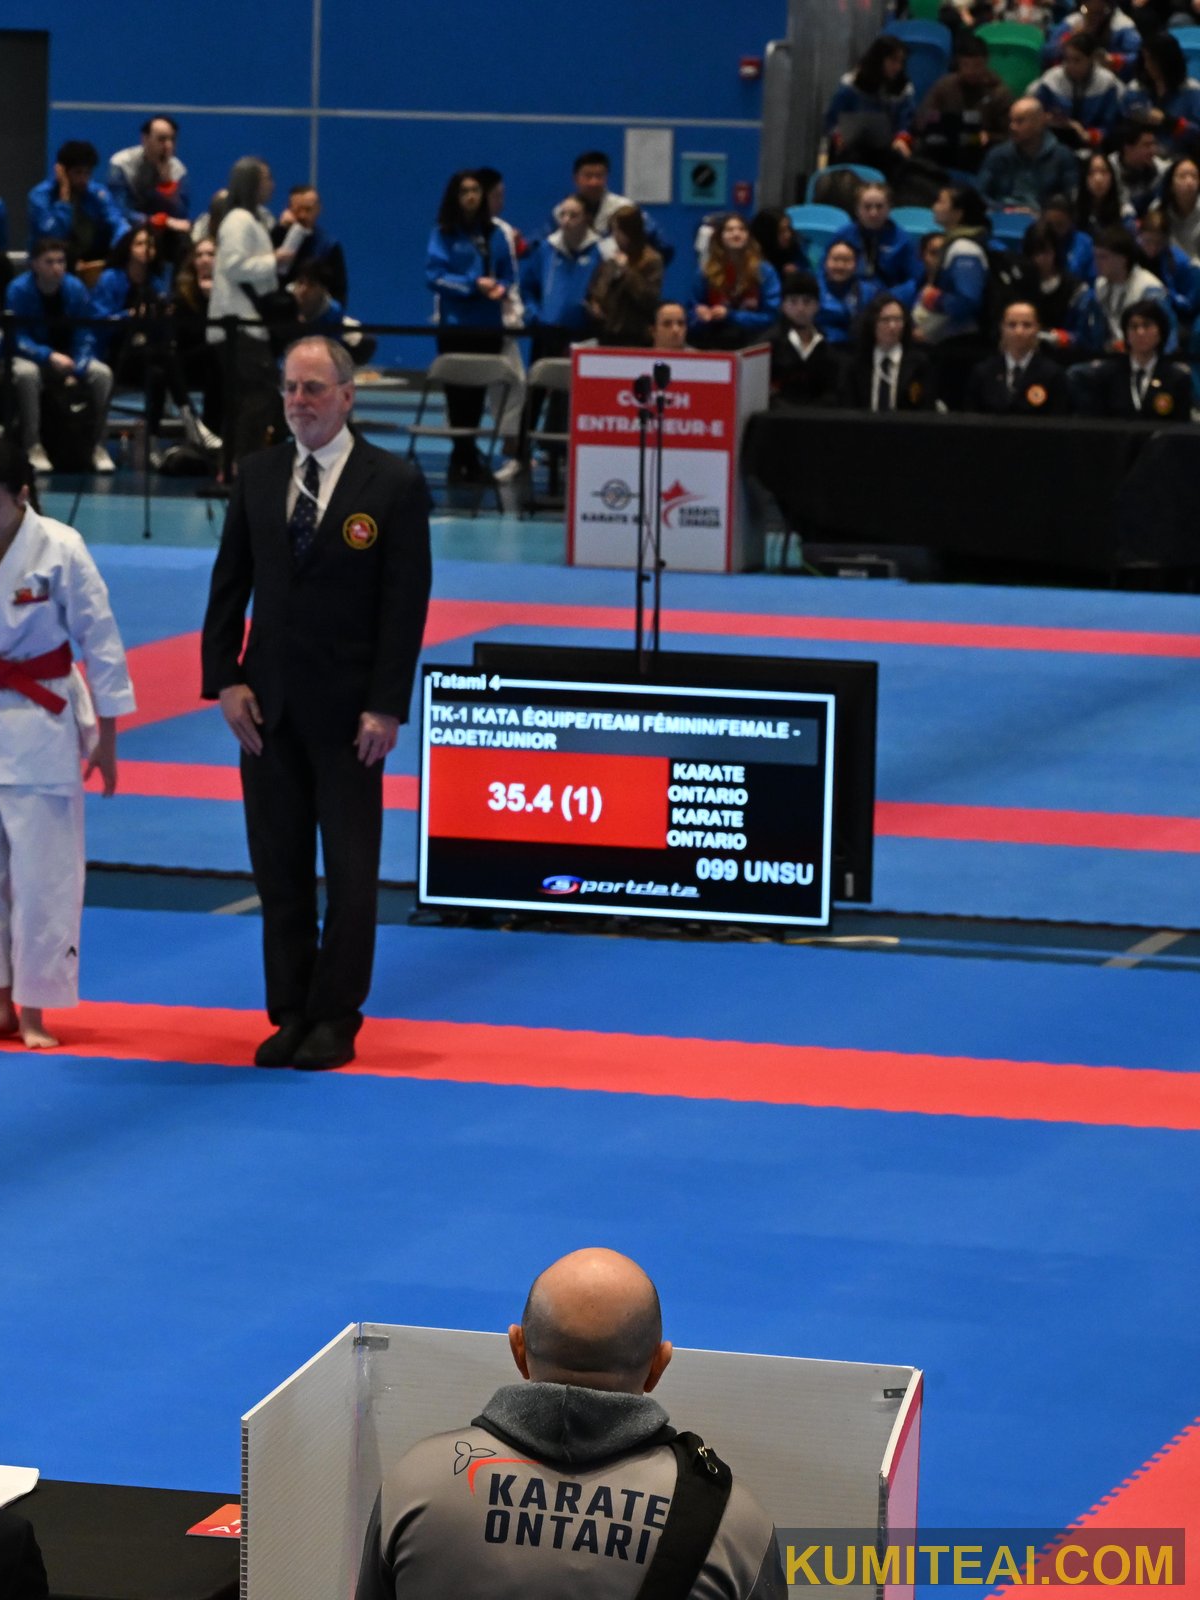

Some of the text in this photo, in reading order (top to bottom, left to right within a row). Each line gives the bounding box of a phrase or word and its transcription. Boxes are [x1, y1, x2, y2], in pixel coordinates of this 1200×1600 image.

[431, 672, 501, 691] Tatami 4
[431, 705, 468, 723] TK-1
[472, 707, 520, 726] KATA
[522, 706, 640, 732] ÉQUIPE/TEAM
[643, 712, 790, 739] FÉMININ/FEMALE
[430, 728, 557, 750] CADET/JUNIOR
[673, 763, 745, 783] KARATE
[488, 781, 603, 823] 35.4 (1)
[667, 785, 748, 805] ONTARIO
[672, 807, 744, 828] KARATE
[666, 829, 747, 850] ONTARIO
[696, 857, 814, 885] 099 UNSU
[488, 1473, 671, 1530] KARATE
[484, 1509, 654, 1565] ONTARI
